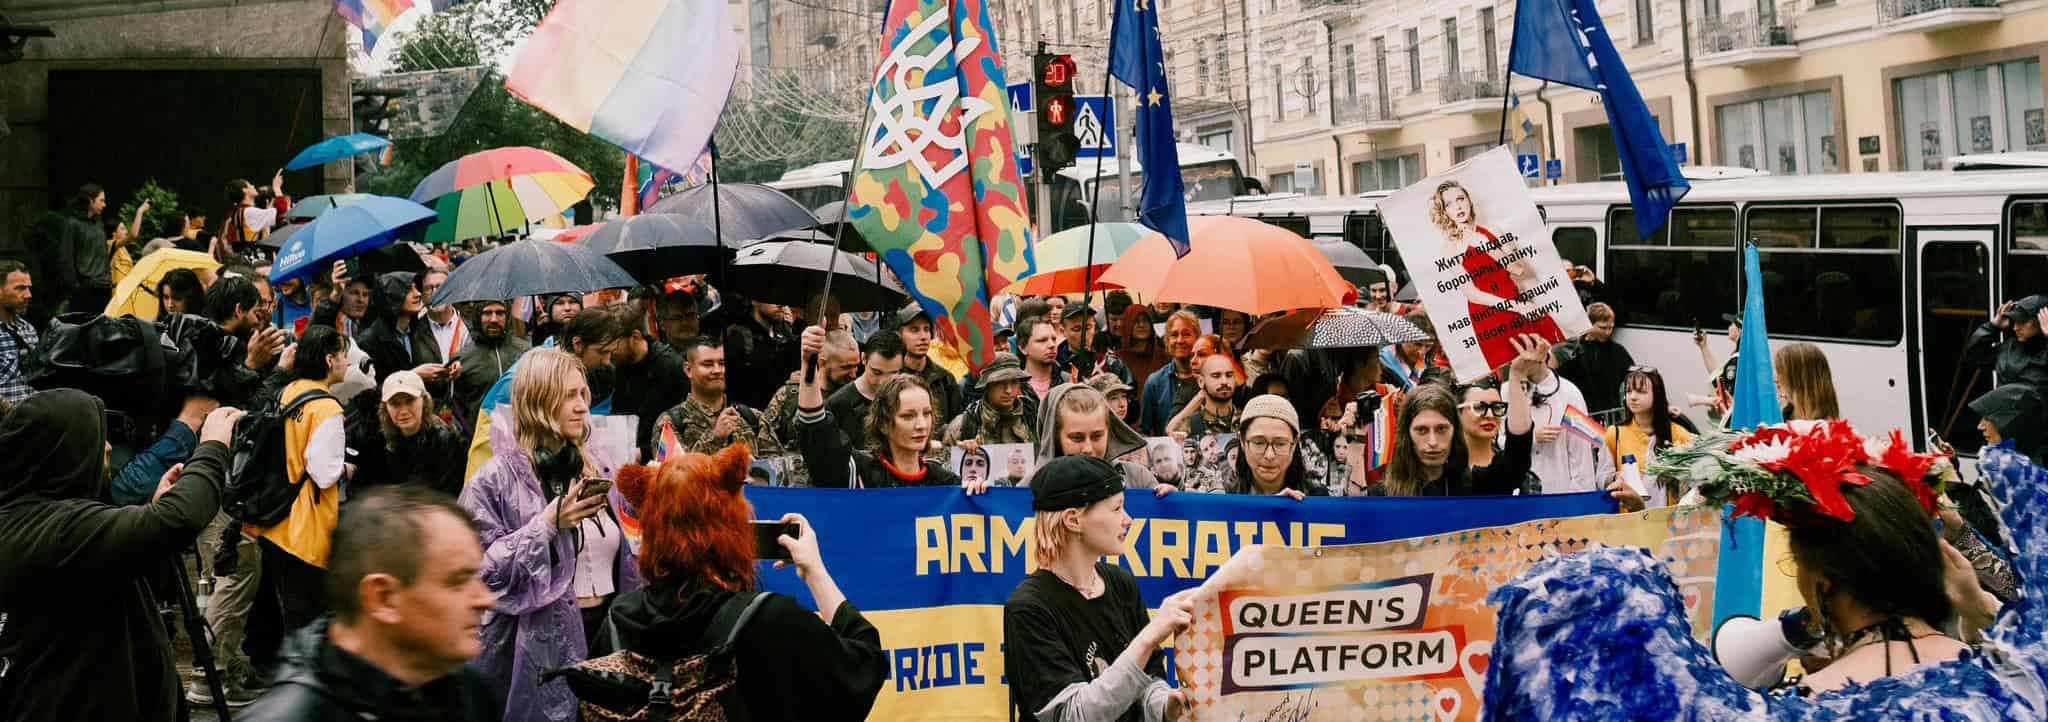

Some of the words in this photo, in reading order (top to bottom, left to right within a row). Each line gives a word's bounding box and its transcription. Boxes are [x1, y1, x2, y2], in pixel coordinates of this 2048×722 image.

[1495, 243, 1538, 270] країну,
[1447, 314, 1472, 333] мав
[1515, 276, 1559, 304] кращий
[1462, 335, 1477, 348] за
[915, 514, 1038, 575] ARM
[1104, 518, 1346, 579] KRAIN
[1239, 597, 1405, 629] QUEEN'S
[1243, 638, 1445, 677] PLATFORM
